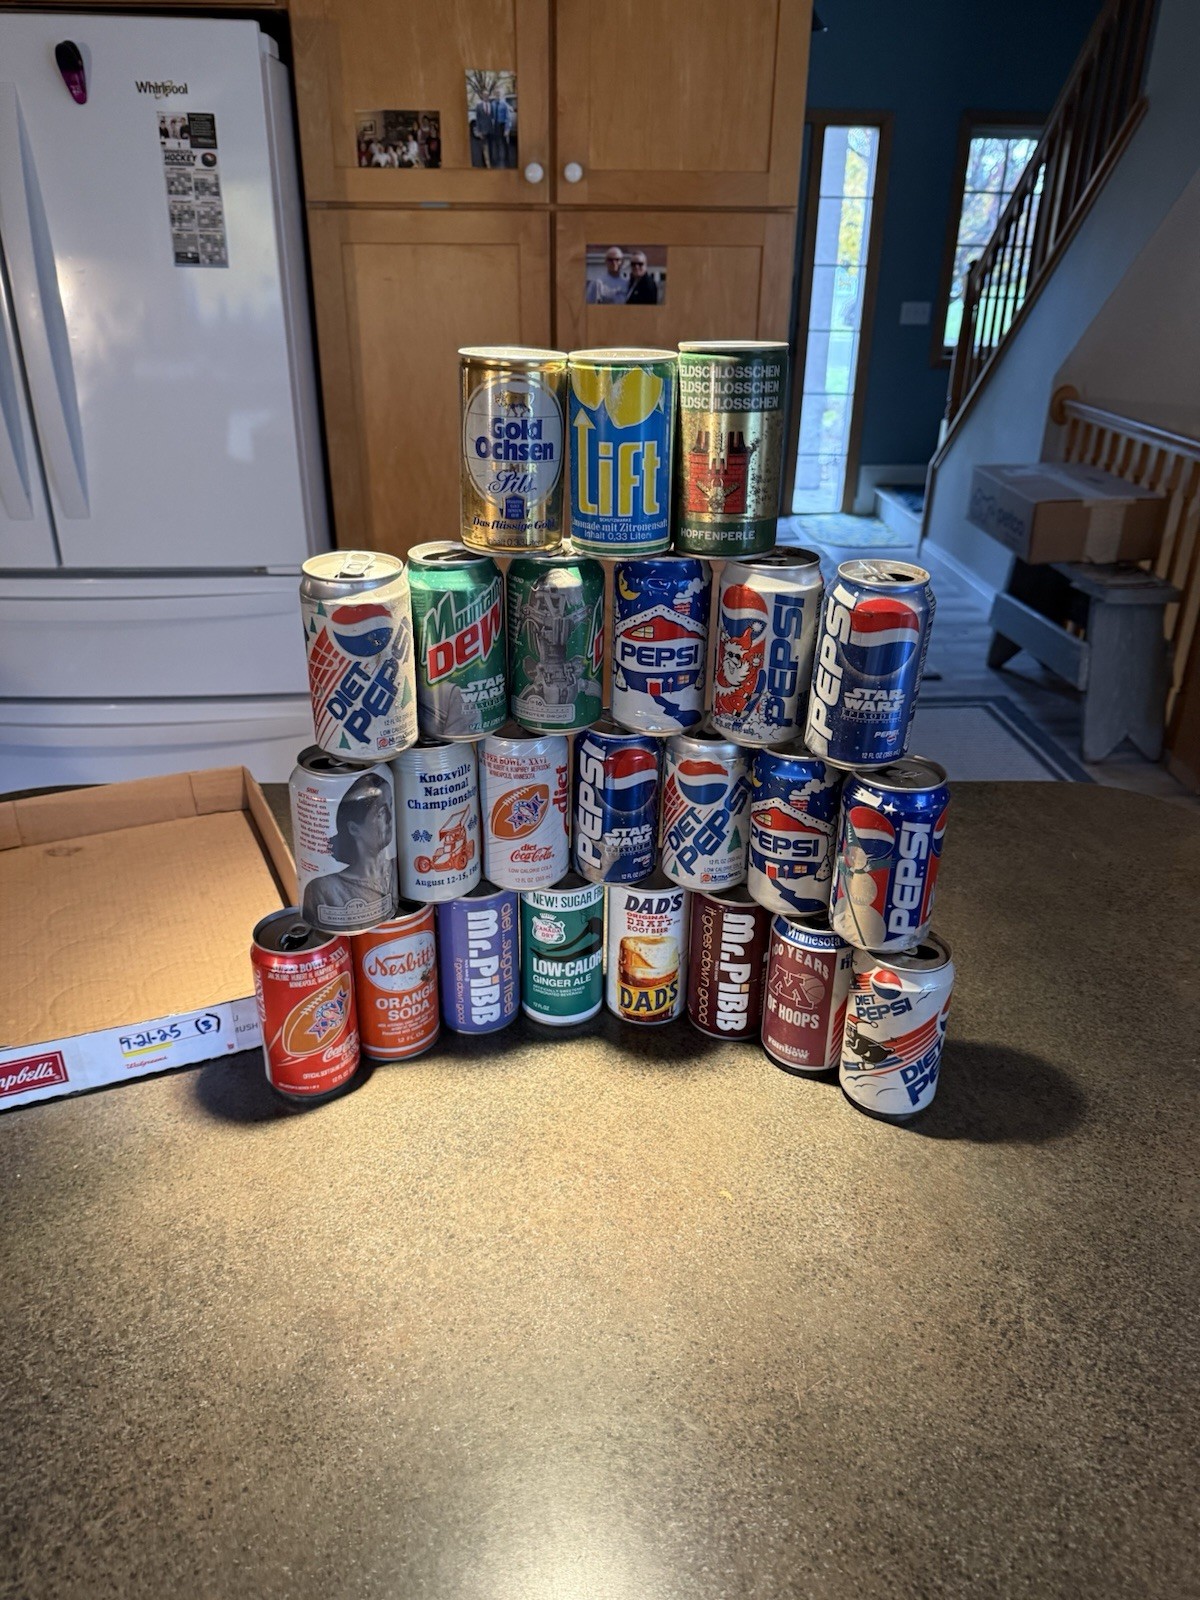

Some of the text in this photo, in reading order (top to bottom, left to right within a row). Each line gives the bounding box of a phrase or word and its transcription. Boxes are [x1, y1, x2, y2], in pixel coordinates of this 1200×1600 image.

[135, 80, 188, 97] Whirlpool
[491, 418, 542, 440] Gold
[475, 436, 554, 460] Ochsen
[573, 408, 661, 517] Lift
[488, 470, 537, 494] Pils
[473, 516, 489, 527] Das
[602, 524, 617, 532] mit
[619, 519, 668, 532] Zitronensaft
[584, 530, 605, 540] Inhalt
[607, 532, 628, 541] 0,33
[681, 527, 756, 541] HOPFENPERLE
[421, 575, 503, 665] Mountain
[621, 642, 699, 668] PEPSI
[763, 593, 805, 728] PEPSI
[810, 584, 858, 741] PEPSI
[326, 661, 371, 721] DIET
[344, 616, 413, 745] PEPSI
[460, 674, 505, 693] STAR
[460, 681, 506, 703] WARS
[844, 688, 906, 701] STAR
[844, 697, 905, 712] WARS
[419, 764, 471, 783] Knoxville
[424, 777, 468, 797] National
[552, 763, 568, 814] diet
[578, 739, 607, 869] PEPSI
[604, 824, 653, 838] STAR
[668, 806, 702, 851] DIET
[676, 776, 752, 876] PEPSI
[604, 831, 652, 847] WARS
[751, 826, 819, 858] PEPSI
[510, 845, 553, 863] Coca-Cola
[415, 879, 445, 888] August
[447, 872, 469, 884] 12-15,
[888, 820, 931, 935] PEPSI
[532, 892, 558, 908] NEW!
[560, 891, 592, 908] SUGAR
[624, 893, 683, 914] DAD'S
[501, 903, 513, 932] diet
[626, 912, 669, 920] ORIGINAL
[627, 917, 673, 928] DRAFT
[535, 925, 562, 934] CANADA
[627, 925, 669, 935] ROOT BEER
[702, 914, 714, 950] goes
[787, 927, 840, 947] Minnesota
[368, 943, 434, 977] Nesbitt's
[532, 946, 603, 977] LOW-CALOR
[701, 950, 712, 987] down
[787, 946, 829, 981] YEARS
[533, 973, 591, 987] GINGER ALE
[376, 982, 435, 1010] ORANGE
[620, 980, 679, 1012] DAD'S
[698, 986, 710, 1026] good
[855, 994, 875, 1006] DIET
[388, 998, 430, 1021] SODA
[456, 1003, 467, 1025] good
[767, 993, 820, 1029] OF HOOPS
[856, 998, 912, 1020] PEPSI
[119, 1024, 181, 1049] 9-21-25
[768, 1034, 810, 1059] rainbow
[0, 1062, 56, 1091] mpbell's
